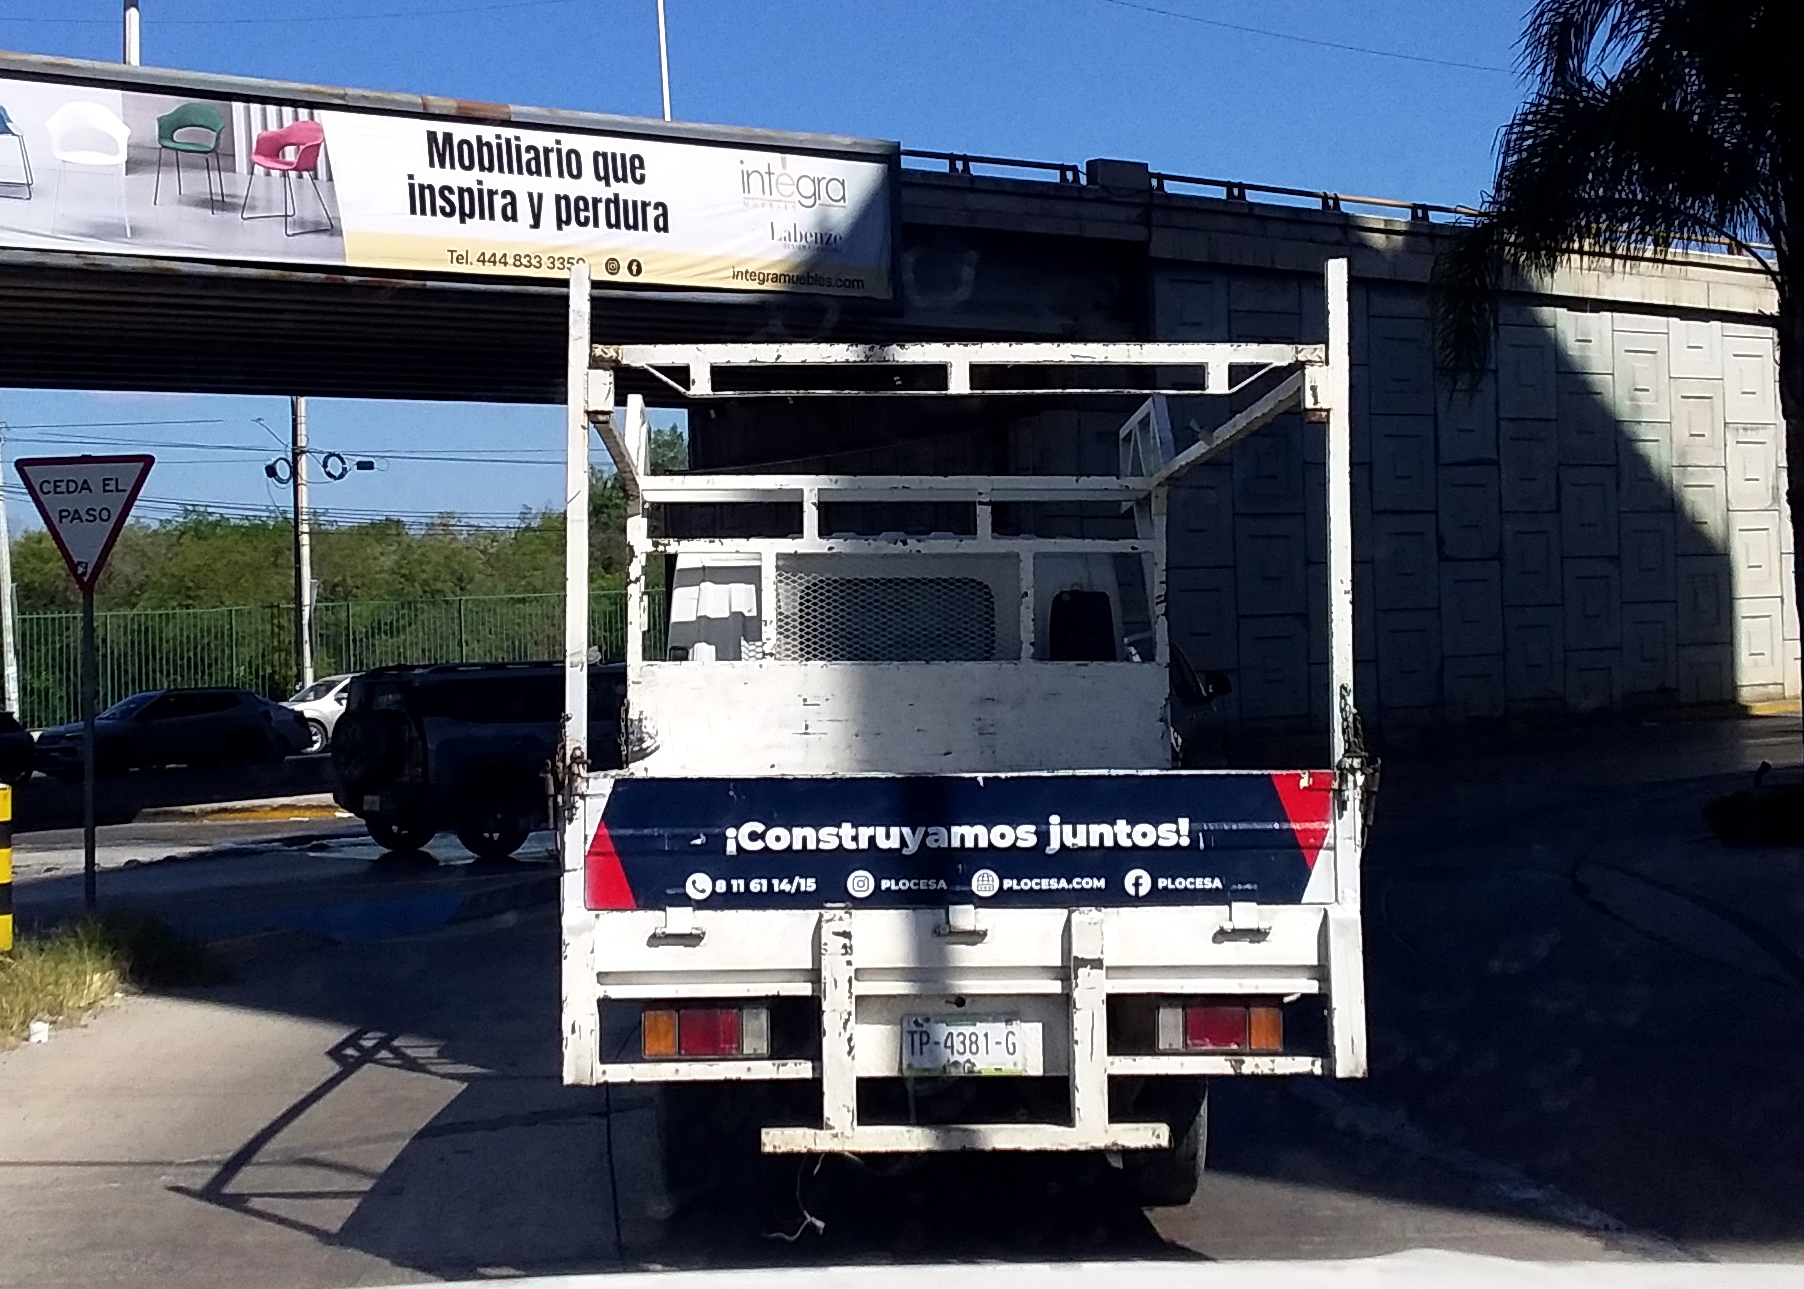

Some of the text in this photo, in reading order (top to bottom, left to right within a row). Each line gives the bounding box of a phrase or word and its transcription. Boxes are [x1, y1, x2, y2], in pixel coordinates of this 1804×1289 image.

[426, 130, 646, 187] Mobiliario que
[740, 155, 846, 209] integra
[407, 174, 669, 234] inspira y perdura
[770, 221, 843, 246] Labenze
[447, 249, 473, 265] Tel.
[476, 251, 509, 267] 444
[512, 253, 543, 269] 833
[731, 265, 865, 290] integramuebles.com
[39, 477, 128, 496] CEDA EL
[58, 506, 112, 524] PASO
[725, 814, 1191, 855] ¡Construyamos juntos!
[715, 875, 817, 894] 8 11 61 14/15
[880, 878, 948, 891] PLOCESA
[1002, 876, 1106, 890] PLOCESA.COM
[1157, 876, 1223, 890] PLOCESA
[906, 1029, 1017, 1057] TP-4381-G
